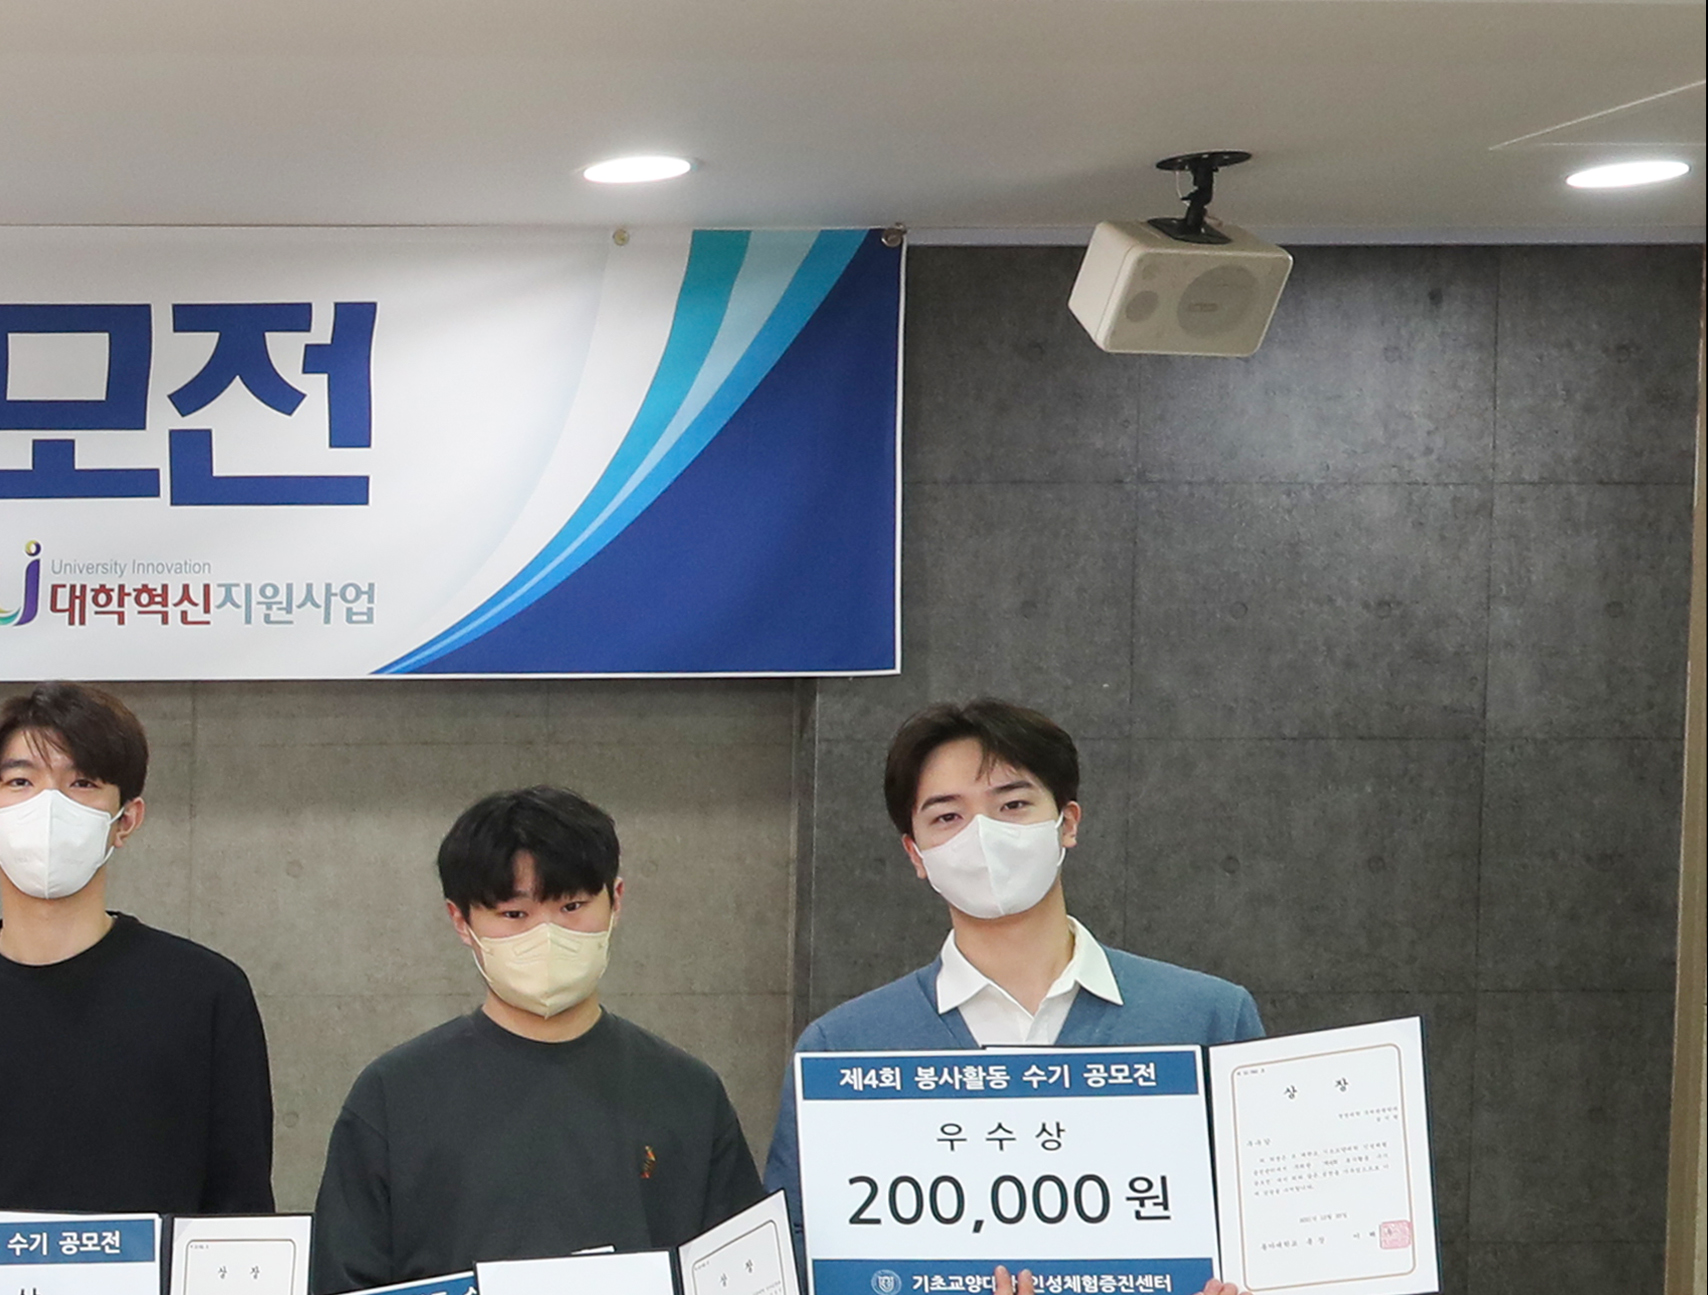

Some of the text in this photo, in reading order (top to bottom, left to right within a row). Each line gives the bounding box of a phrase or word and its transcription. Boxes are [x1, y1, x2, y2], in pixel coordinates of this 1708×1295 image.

[51, 558, 211, 577] University Innovation
[50, 582, 377, 627] 대학혁신지원사업
[839, 1062, 1157, 1091] 제4회 봉사활동 수기 공모전
[848, 1174, 1171, 1234] 200,000 원
[7, 1232, 48, 1256] 수기
[58, 1230, 121, 1255] 공모전
